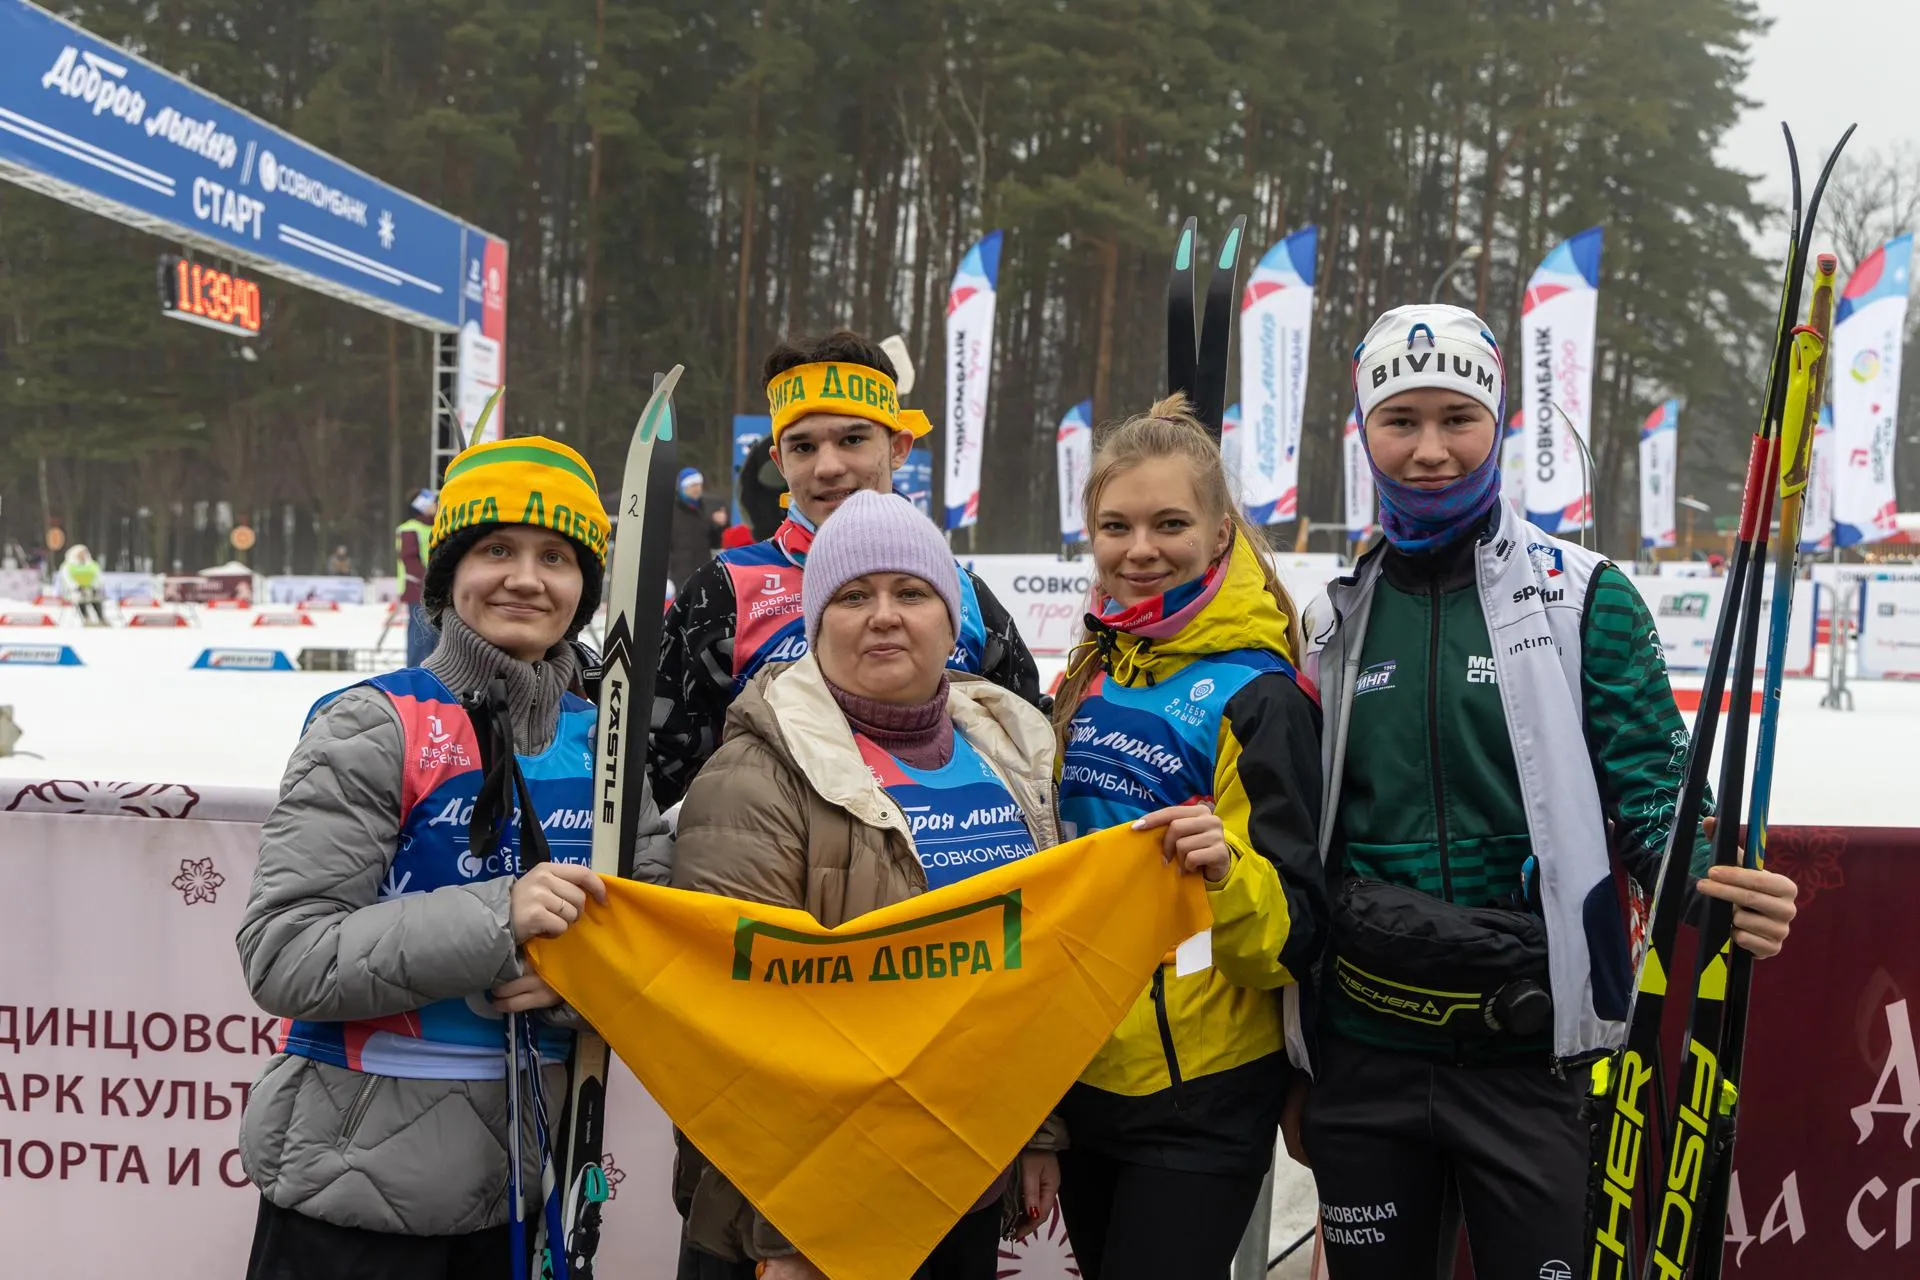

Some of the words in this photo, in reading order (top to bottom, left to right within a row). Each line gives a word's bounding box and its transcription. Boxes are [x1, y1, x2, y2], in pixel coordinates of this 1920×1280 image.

[41, 45, 147, 125] Добрая
[277, 164, 368, 228] СОВКОМБАНК
[192, 176, 265, 240] СТАРТ
[1371, 352, 1494, 394] BIVIUM
[1535, 326, 1555, 483] СОВКОМБАНК
[628, 493, 640, 517] 2
[1013, 576, 1090, 593] СОВКО
[751, 593, 801, 611] ДОБРЫЕ
[1164, 704, 1204, 727] СЛЫШУ
[1171, 697, 1181, 706] Я
[1184, 702, 1206, 718] ТЕБЯ
[919, 843, 1036, 869] СОВКОМБАН
[763, 955, 854, 985] ЛИГА
[868, 939, 993, 981] ДОБРА
[1338, 969, 1420, 1012] FISCHER
[168, 1147, 200, 1187] И
[1320, 1201, 1397, 1223] СКОВСКАЯ
[1323, 1224, 1386, 1245] ОБЛАСТЬ
